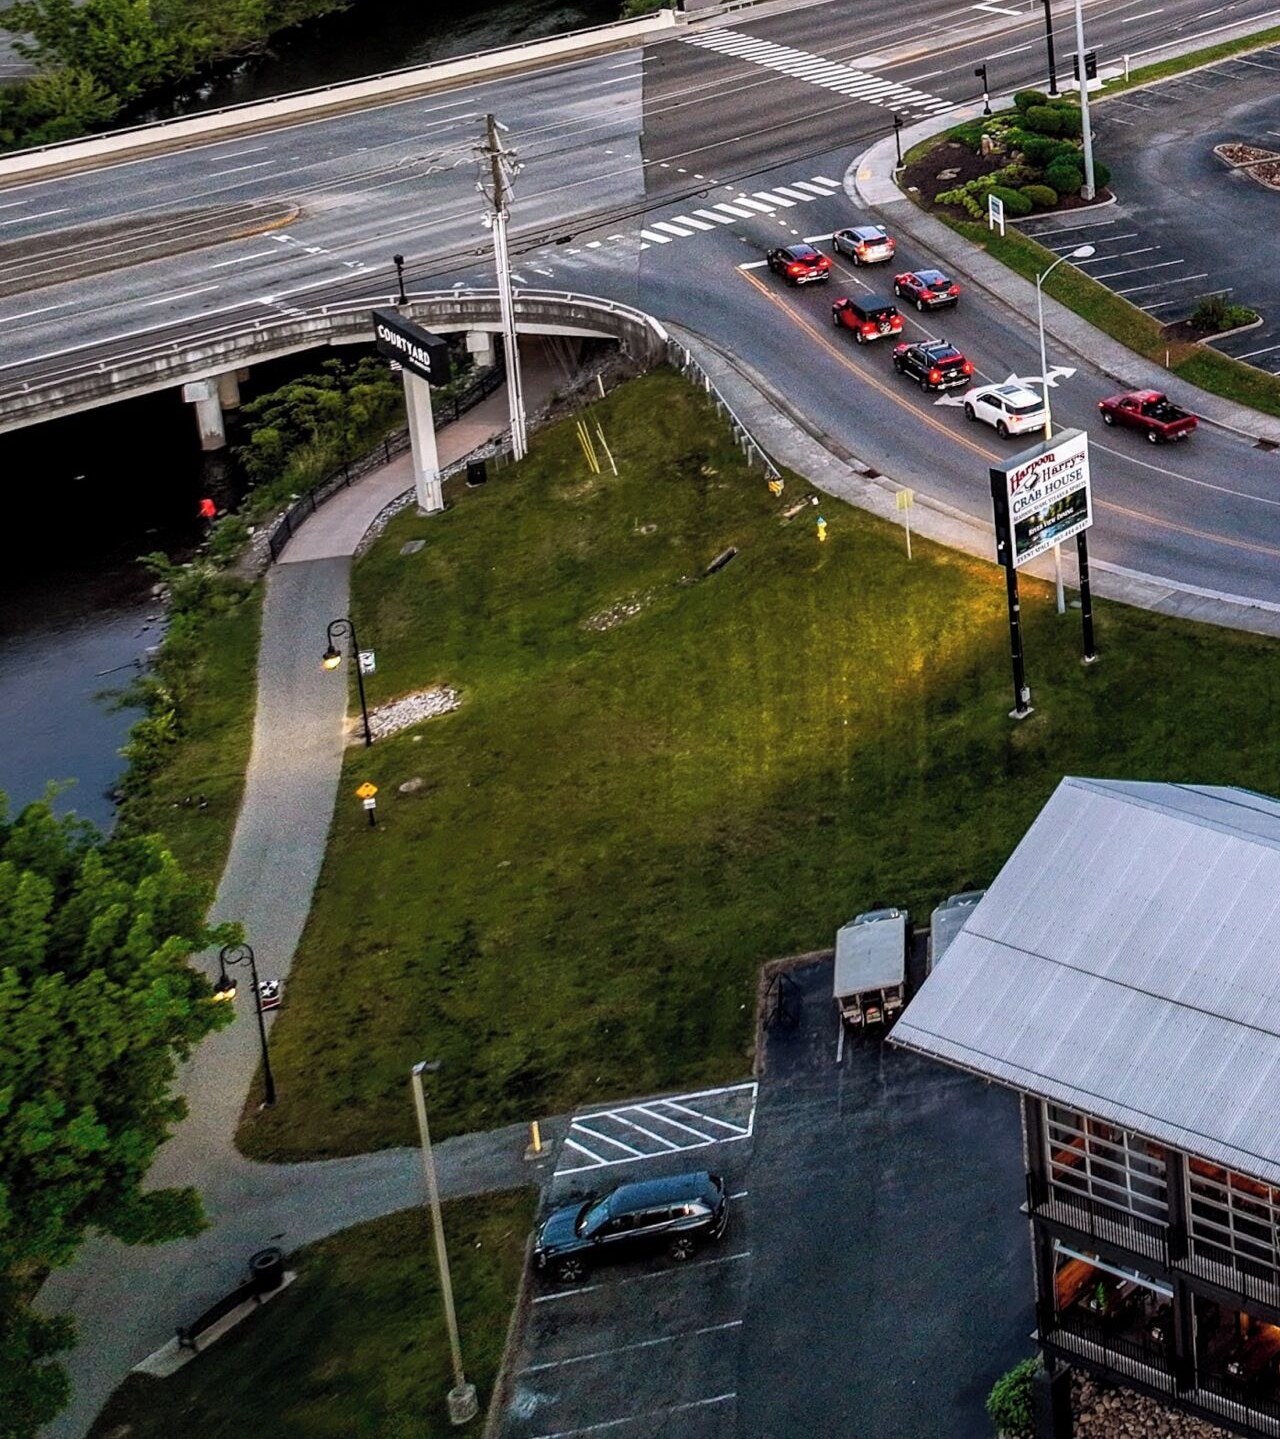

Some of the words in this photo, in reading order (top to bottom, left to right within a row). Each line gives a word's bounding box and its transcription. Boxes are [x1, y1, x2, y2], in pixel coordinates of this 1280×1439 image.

[377, 324, 431, 366] COURTYARD
[1009, 452, 1056, 495] Harpoon
[1042, 450, 1086, 484] Harry's
[1012, 488, 1043, 514] CRAB
[1045, 468, 1083, 495] HOUSE
